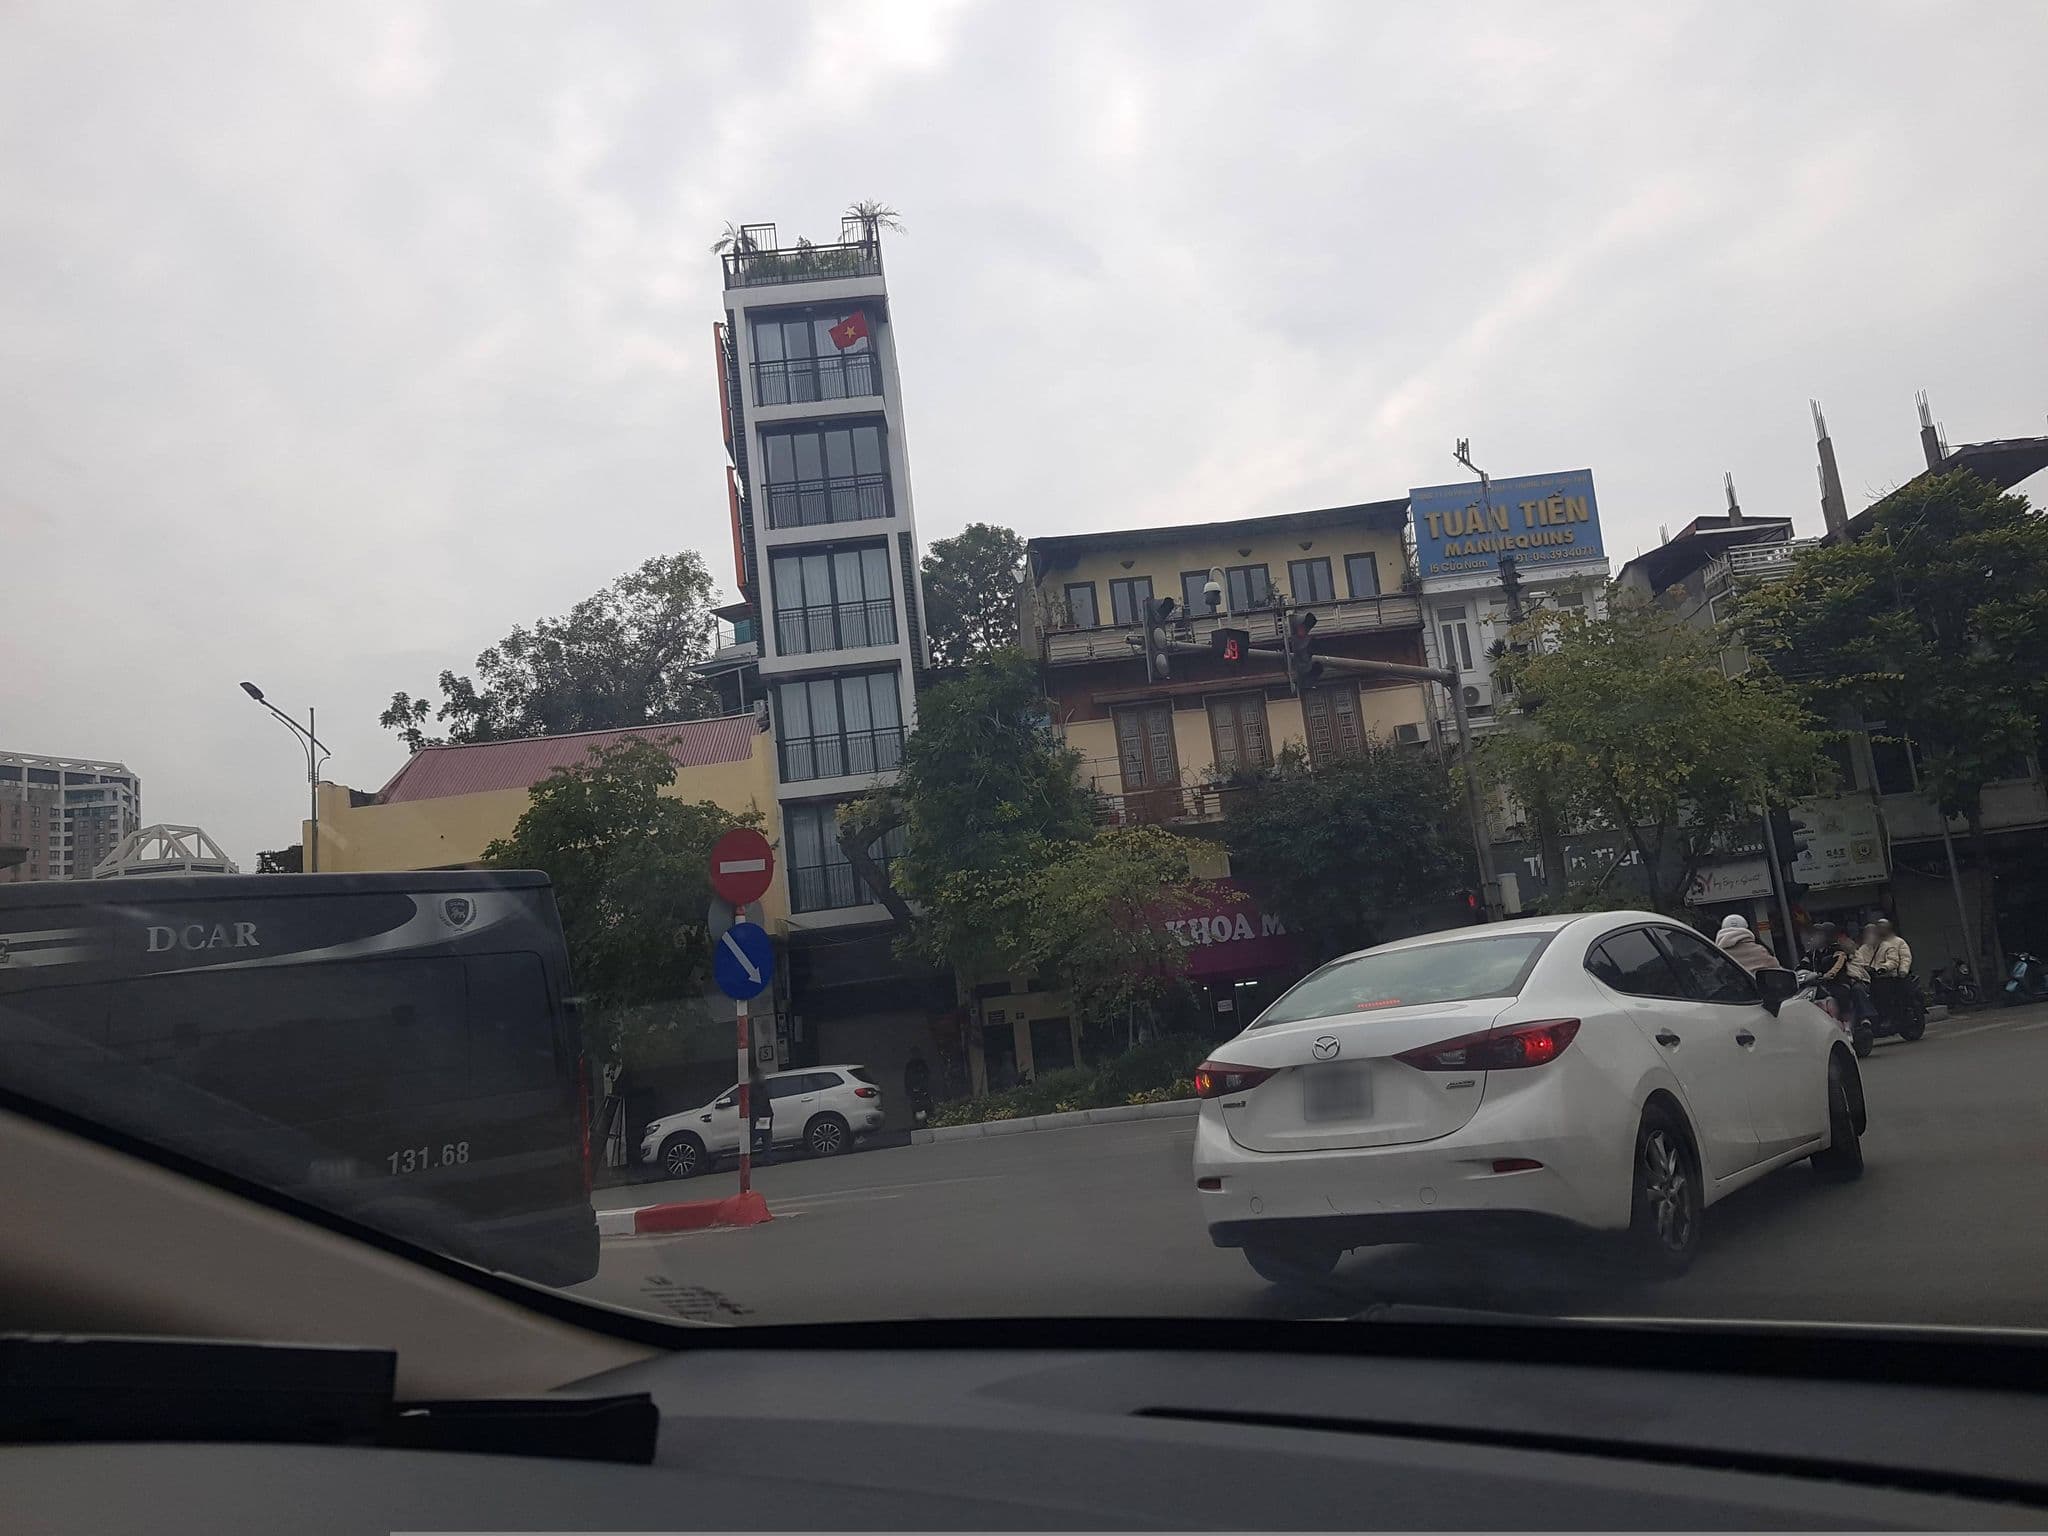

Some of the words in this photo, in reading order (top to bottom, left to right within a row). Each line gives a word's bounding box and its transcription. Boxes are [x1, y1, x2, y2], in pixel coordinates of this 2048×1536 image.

[1424, 499, 1510, 539] TUẤN
[1519, 490, 1590, 528] TIẾN
[1444, 529, 1575, 558] MANNEQUINS
[1464, 560, 1489, 570] Nam
[146, 921, 260, 952] DCAR
[1165, 912, 1255, 945] KHOA
[386, 1140, 470, 1176] 131.68
